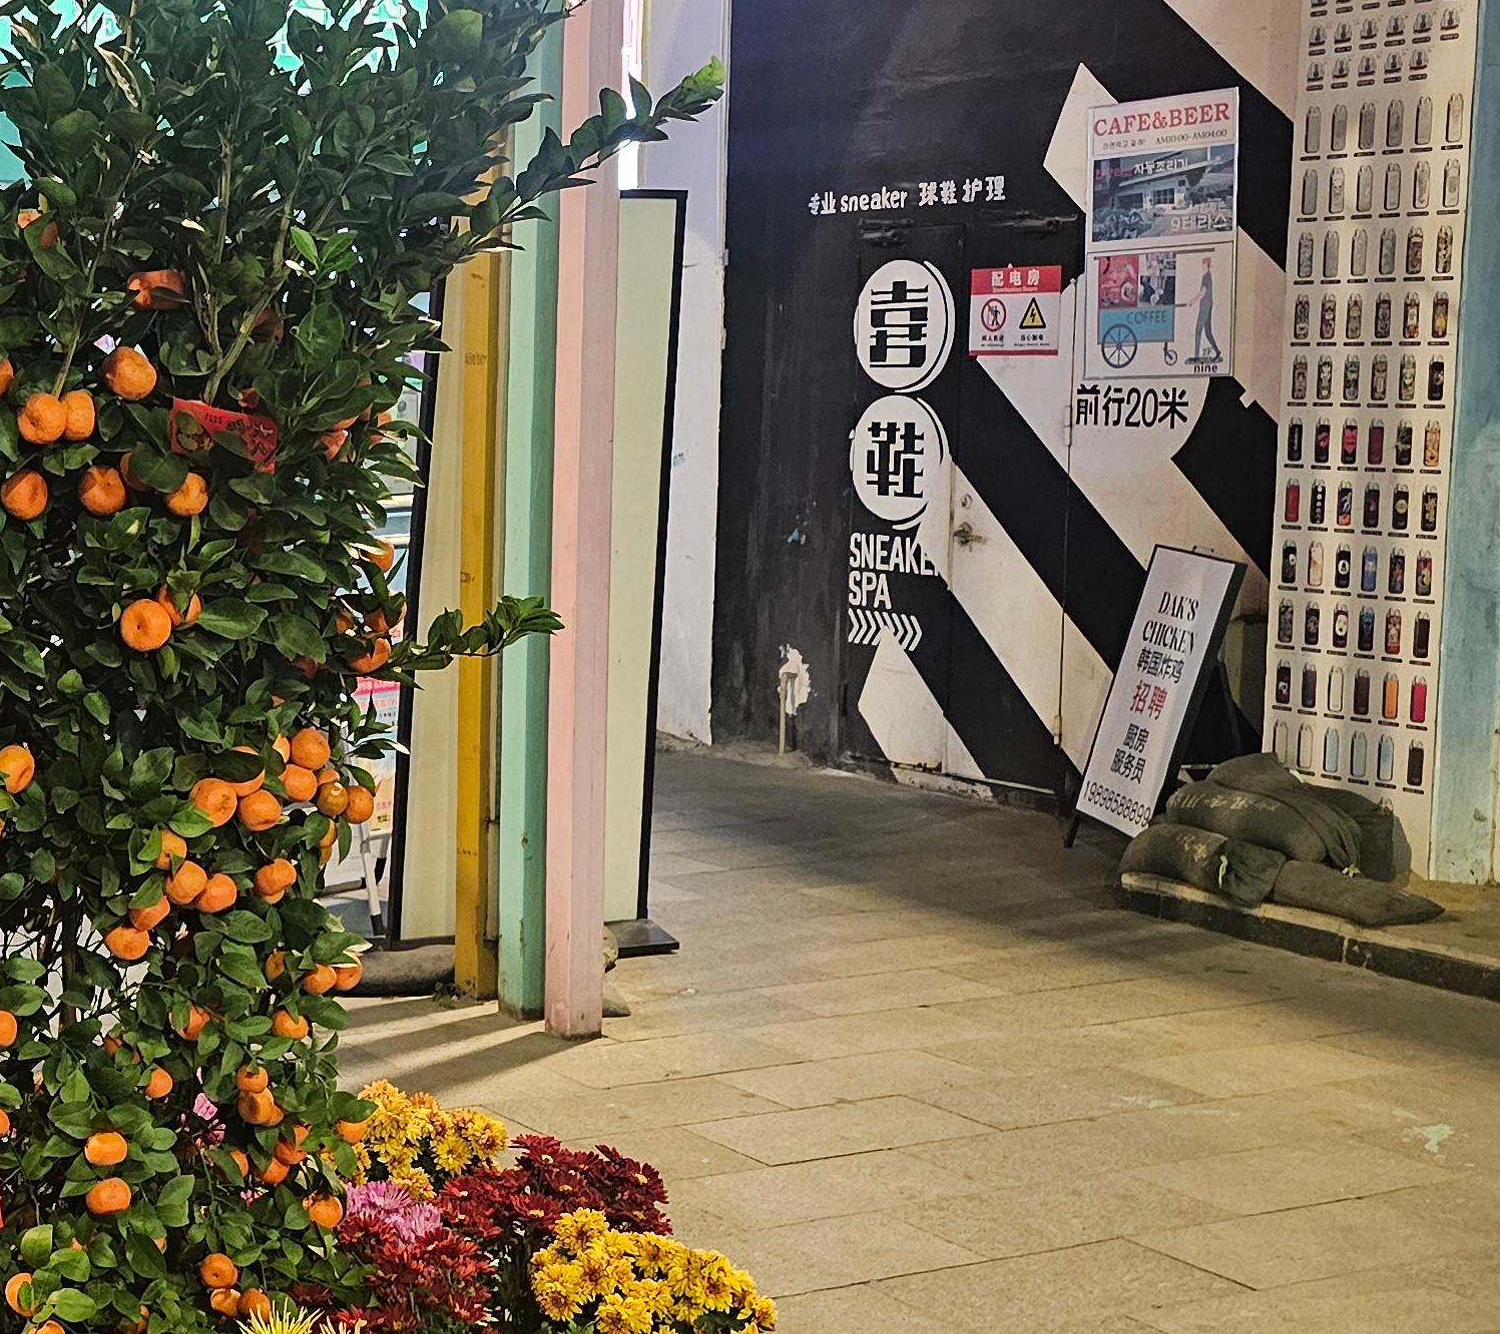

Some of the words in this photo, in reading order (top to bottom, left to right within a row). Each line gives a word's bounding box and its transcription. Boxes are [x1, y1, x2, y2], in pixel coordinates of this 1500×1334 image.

[1093, 102, 1231, 137] CAFE&BEER
[807, 191, 837, 216] 专业
[840, 185, 909, 213] sneaker
[918, 175, 1006, 207] 球鞋护理
[991, 268, 1040, 287] 配电房
[1126, 310, 1168, 325] COFFEE
[1076, 383, 1189, 429] 前行20米
[849, 532, 940, 577] SNEAKE
[848, 570, 893, 610] SPA
[1157, 591, 1199, 622] DAK'S
[1141, 619, 1198, 656] CHICKEN
[1136, 646, 1185, 685] 韩国炸鸡
[1130, 679, 1168, 721] 招聘
[1122, 722, 1150, 755] 厨房
[1110, 748, 1146, 785] 服务员
